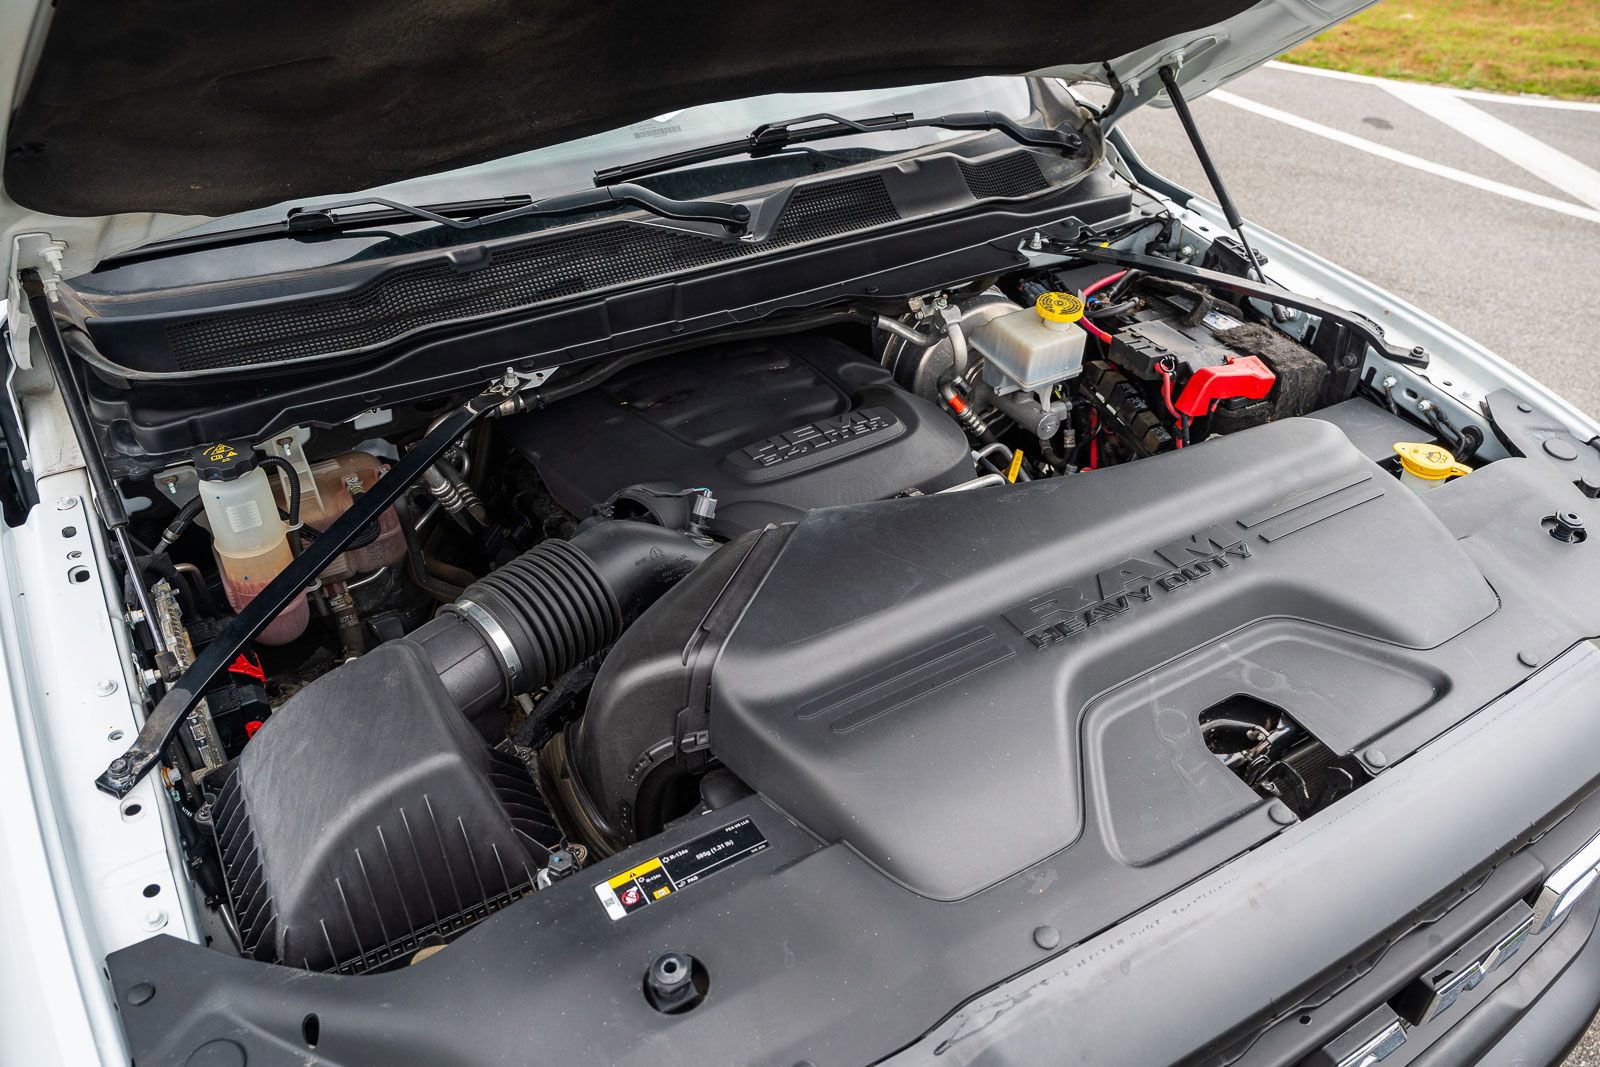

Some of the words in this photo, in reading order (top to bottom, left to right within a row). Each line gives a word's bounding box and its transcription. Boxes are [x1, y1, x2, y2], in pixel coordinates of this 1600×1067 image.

[742, 408, 882, 461] HEMI
[1000, 525, 1246, 637] RAM
[1026, 583, 1154, 650] HEAVY
[1156, 542, 1252, 593] DUTY
[669, 848, 689, 861] R-134a
